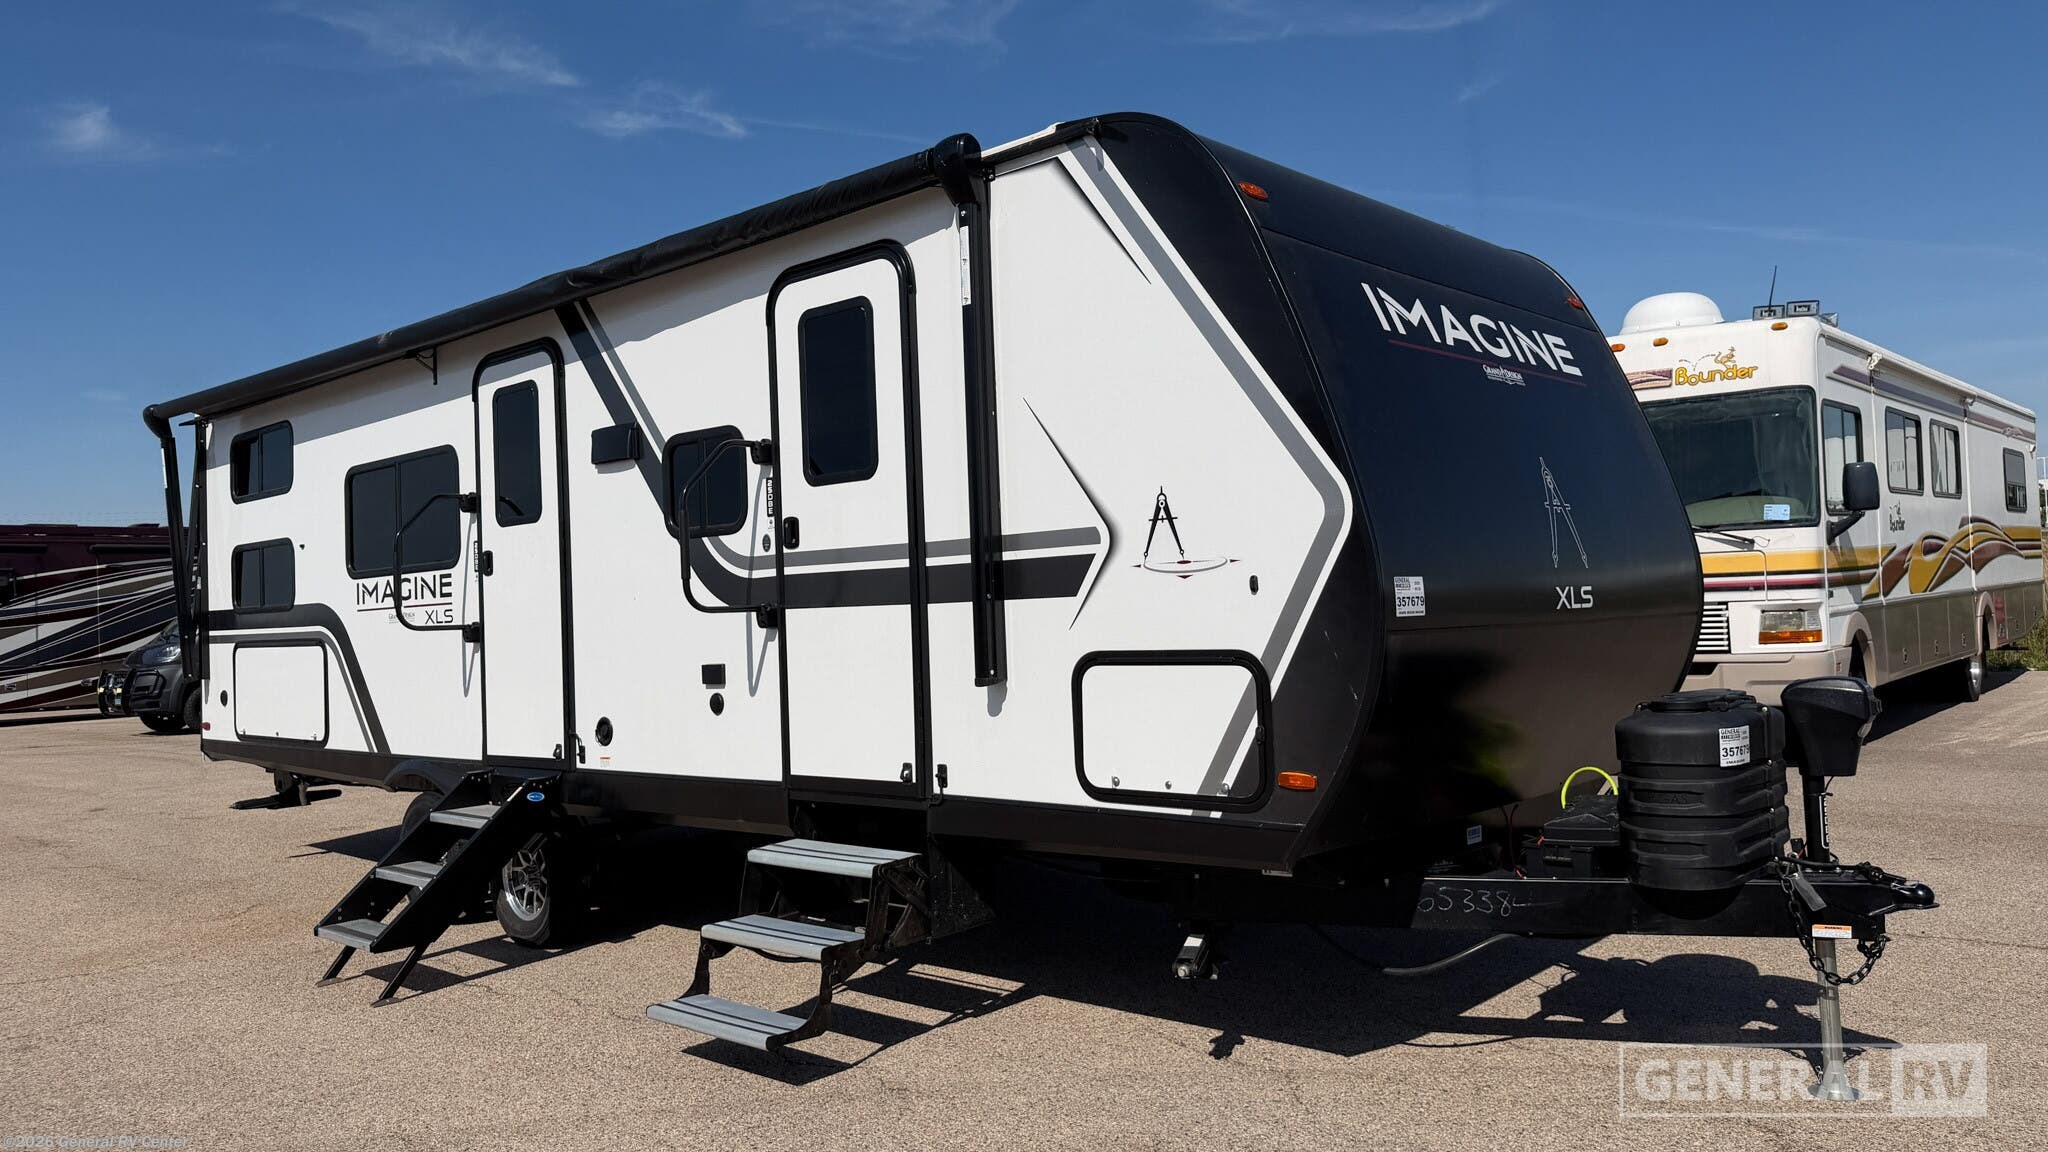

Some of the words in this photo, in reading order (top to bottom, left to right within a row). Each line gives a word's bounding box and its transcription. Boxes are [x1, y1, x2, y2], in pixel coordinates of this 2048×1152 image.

[1360, 282, 1583, 377] IMAGINE
[1675, 364, 1759, 386] Bounder
[356, 573, 453, 605] IMAGINE
[1555, 586, 1593, 609] XLS
[1396, 595, 1425, 607] 357679
[425, 608, 454, 625] XLS
